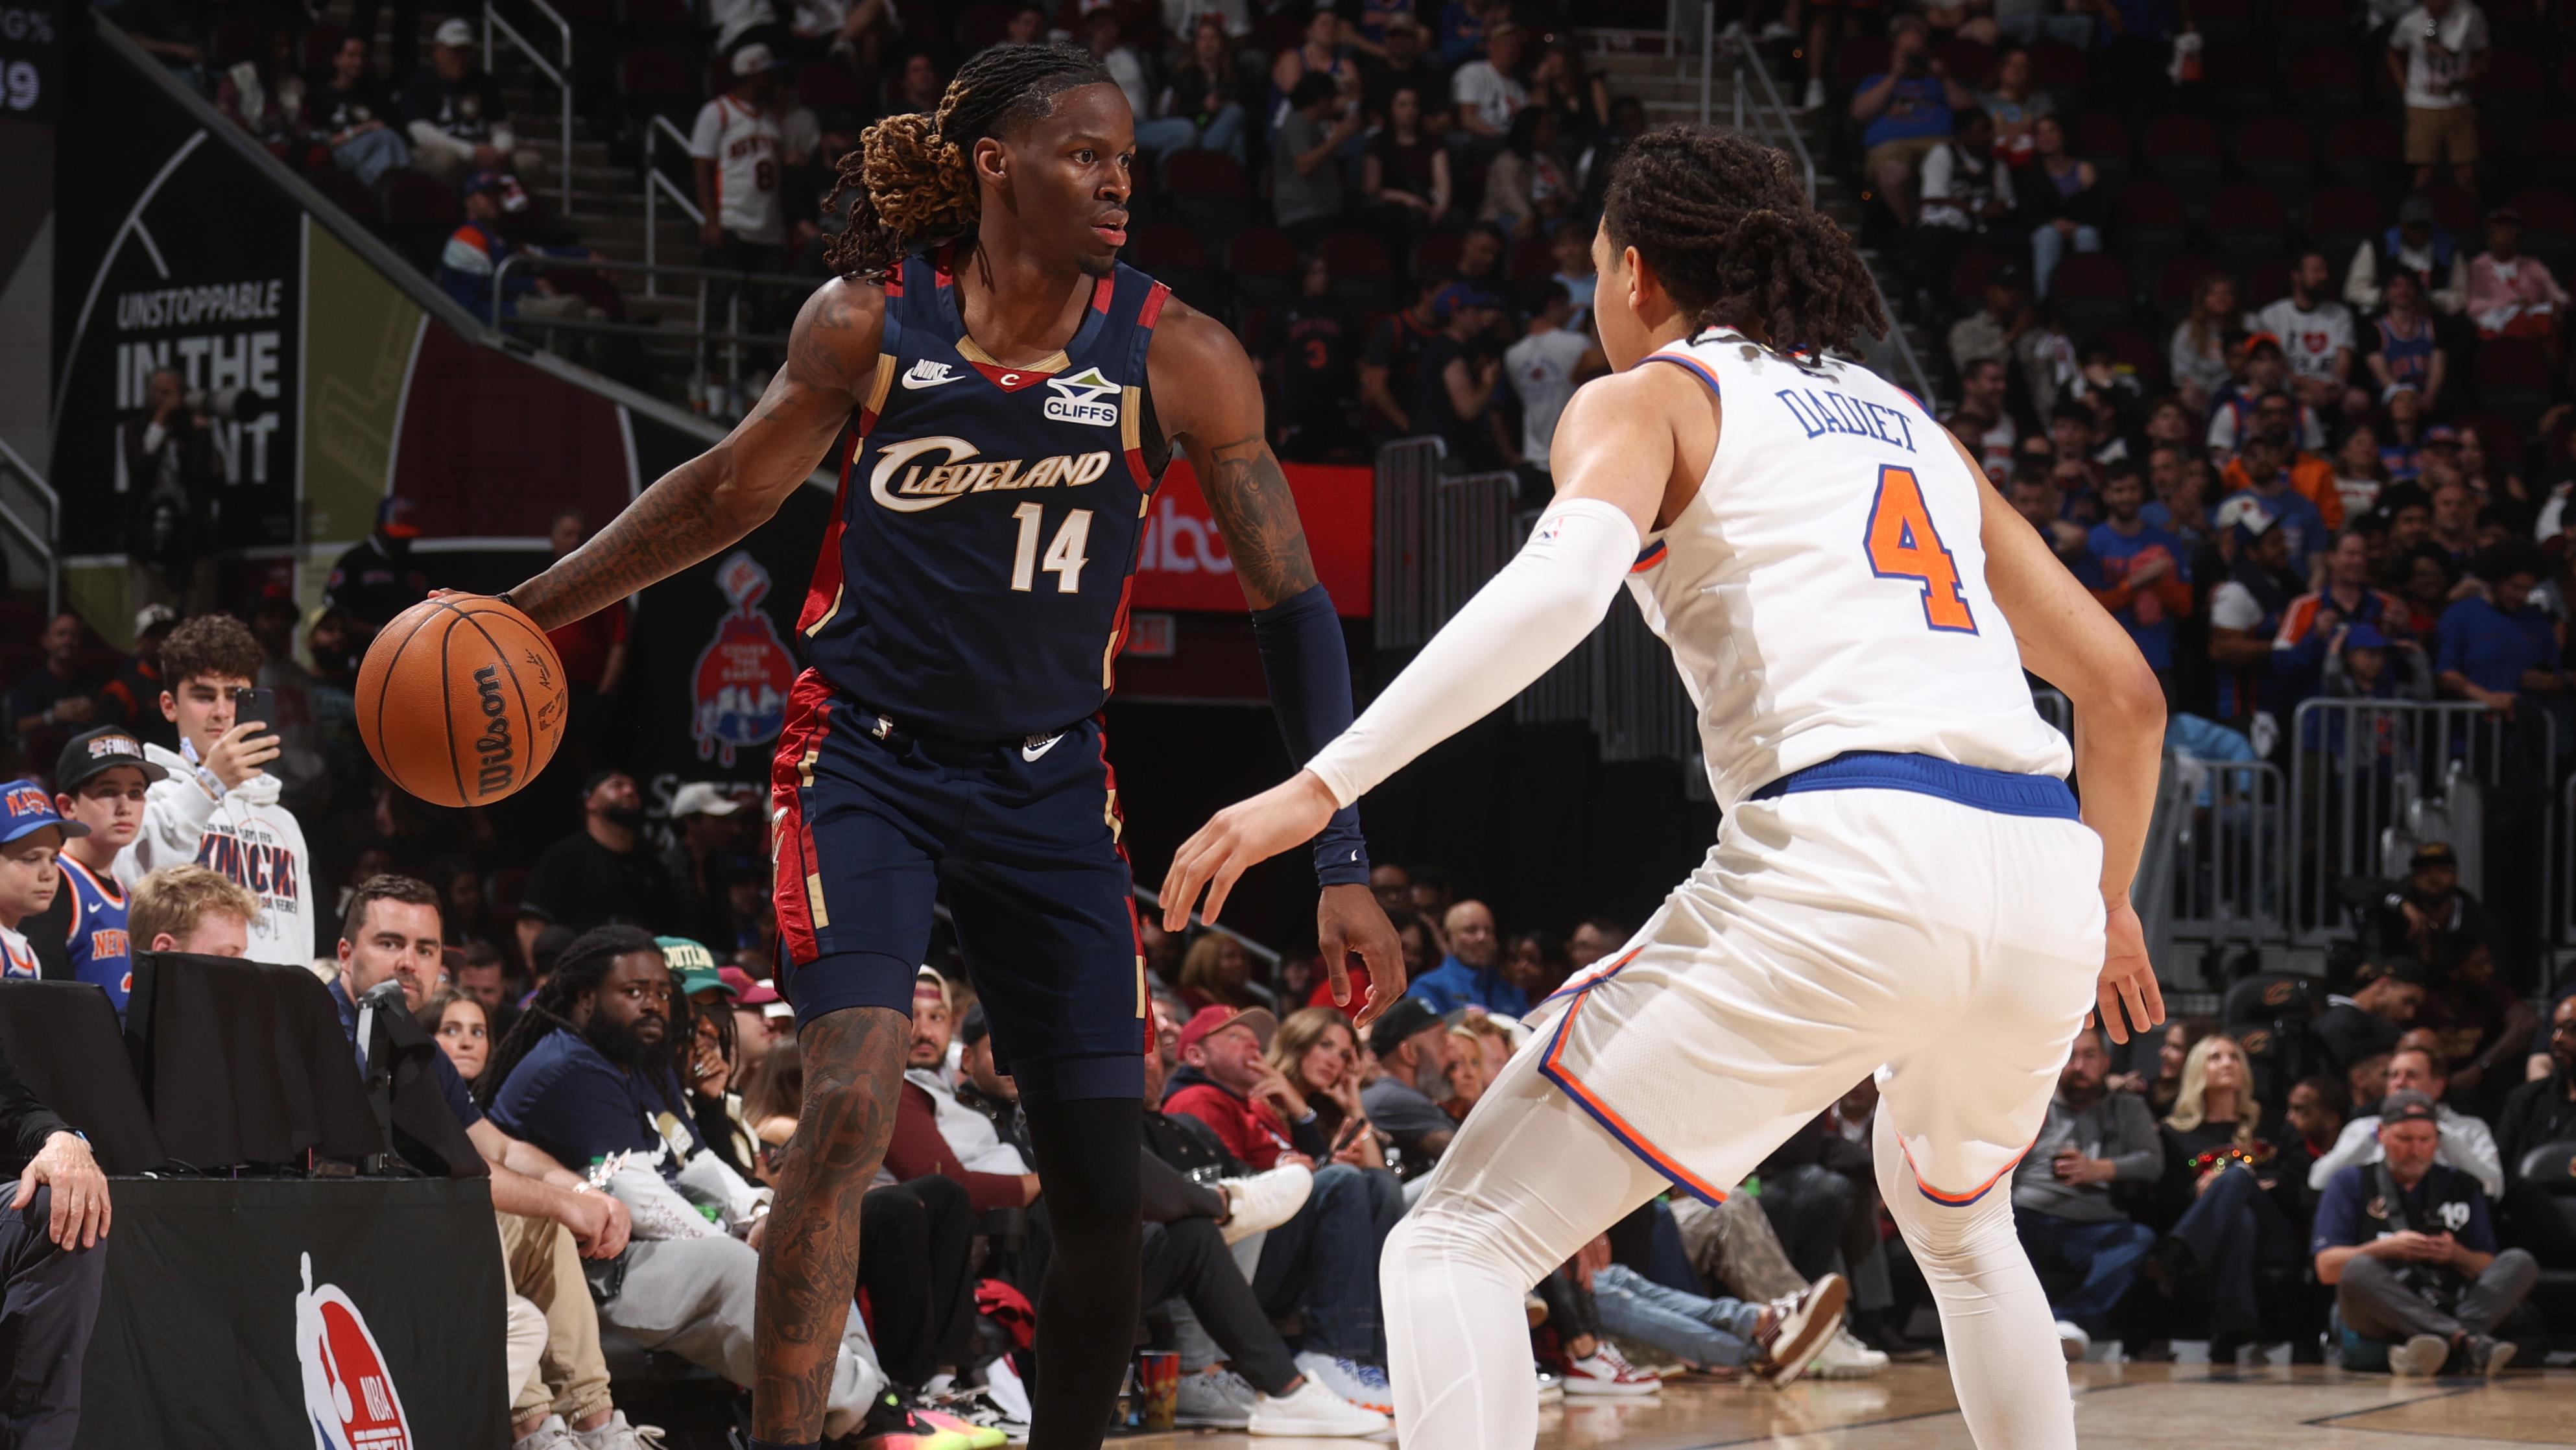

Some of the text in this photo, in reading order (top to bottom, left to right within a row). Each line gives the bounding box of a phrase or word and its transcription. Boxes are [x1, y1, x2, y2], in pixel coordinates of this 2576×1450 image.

[0, 58, 40, 111] 9
[116, 279, 283, 331] UNSTOPPABLE
[116, 331, 281, 410] IN THE
[911, 359, 952, 381] NIKE
[1047, 402, 1114, 422] CLIFFS
[1775, 388, 1917, 454] DADIET
[870, 436, 1111, 512] CLEVELAND
[1011, 501, 1093, 593] 14
[1863, 463, 1980, 637] 4
[473, 663, 514, 798] Wilson
[2437, 1201, 2470, 1231] 19
[359, 1375, 395, 1422] NBA
